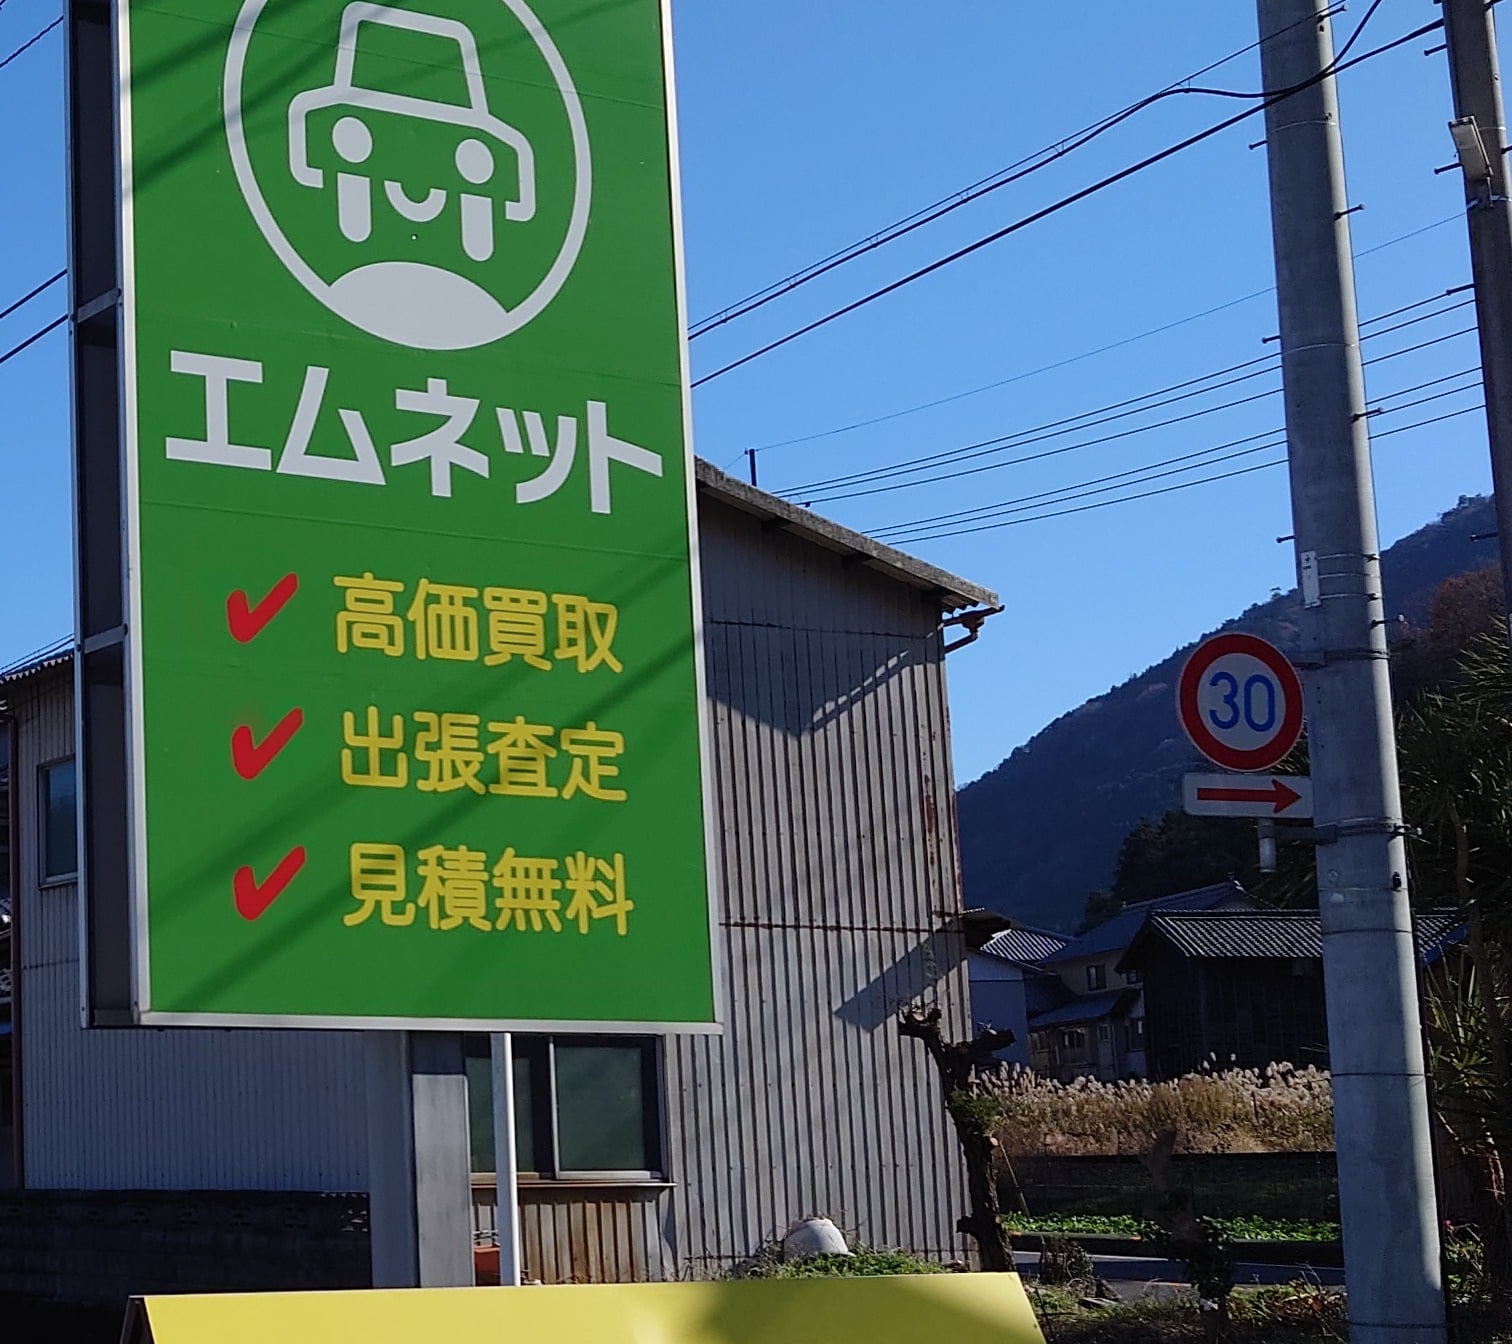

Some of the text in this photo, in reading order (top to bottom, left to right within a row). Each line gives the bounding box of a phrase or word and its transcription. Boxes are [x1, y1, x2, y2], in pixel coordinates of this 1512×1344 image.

[165, 349, 663, 515] エムネット
[333, 572, 623, 674] 高価買取
[1209, 672, 1276, 732] 30
[340, 705, 628, 802] 出張査定
[341, 842, 634, 936] 見積無料
